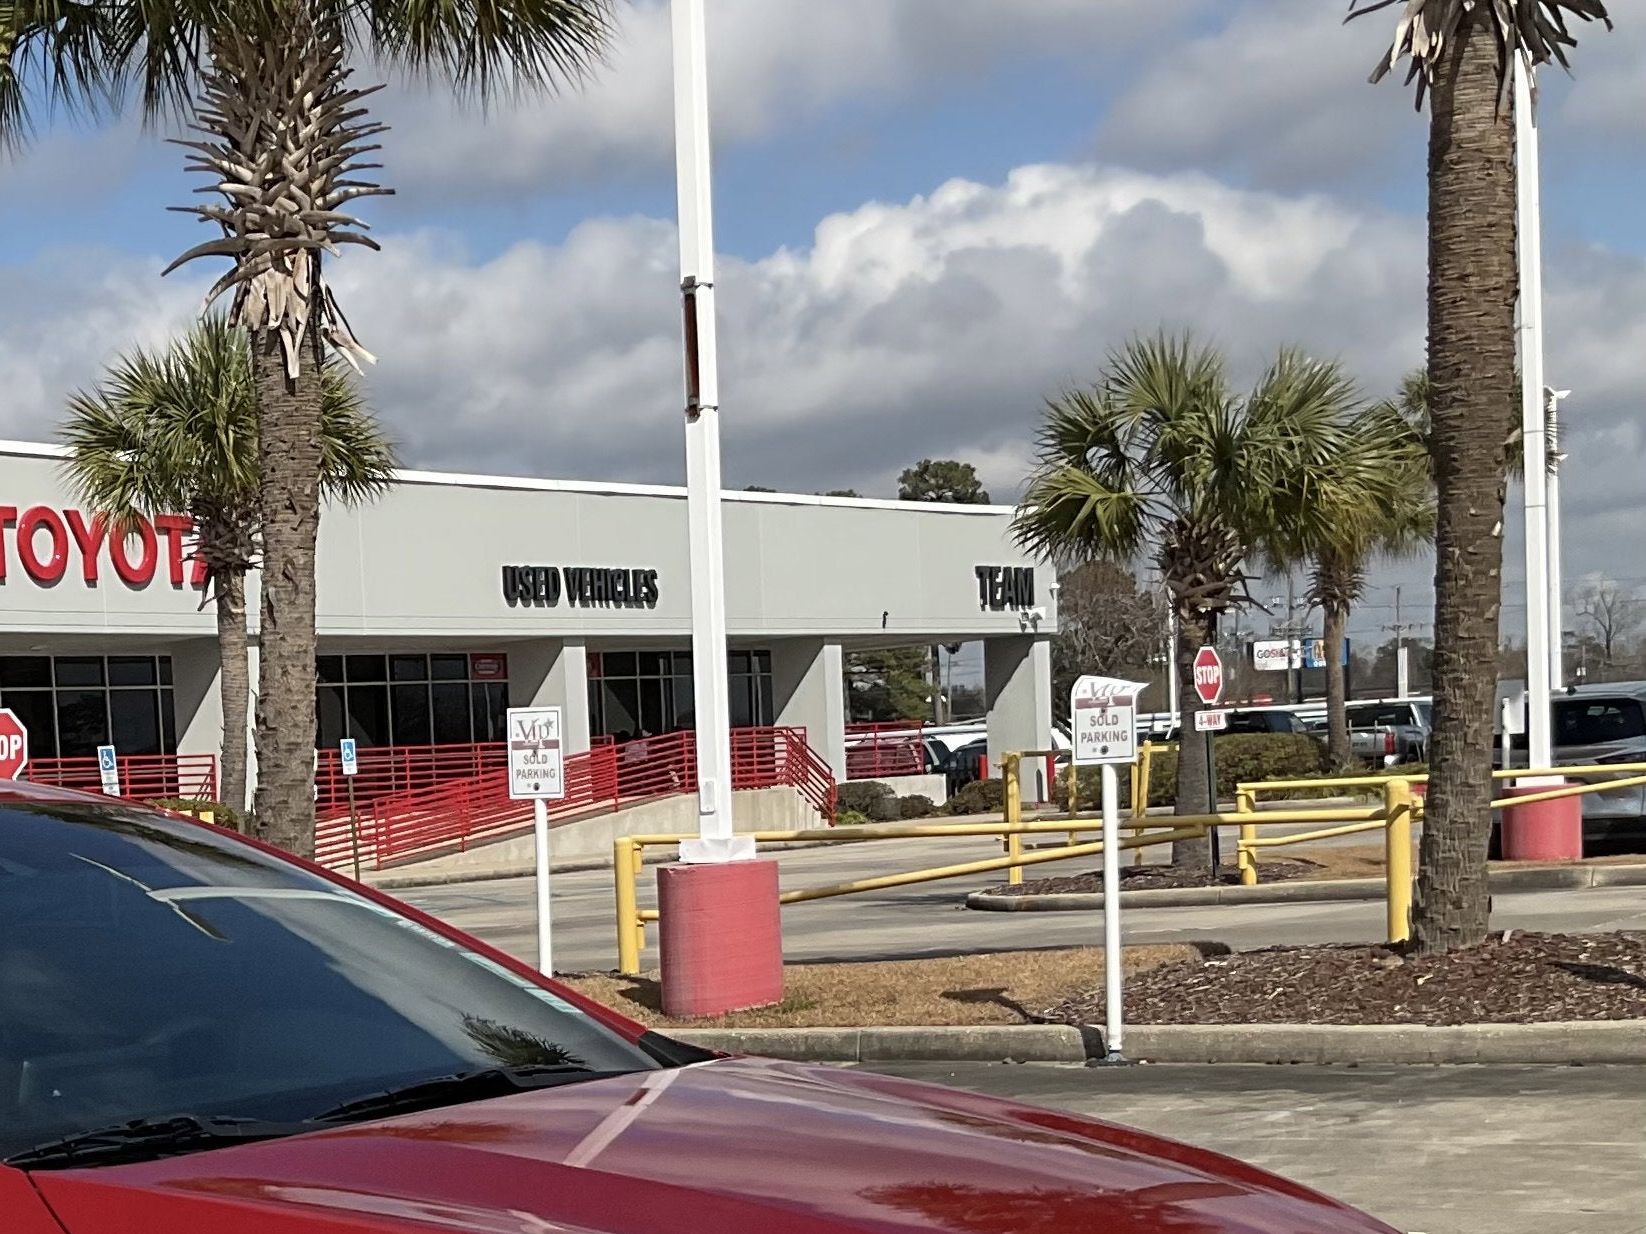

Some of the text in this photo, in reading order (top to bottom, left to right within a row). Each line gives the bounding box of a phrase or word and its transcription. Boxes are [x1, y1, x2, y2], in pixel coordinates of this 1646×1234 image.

[502, 566, 658, 605] USED VEHICLES
[975, 566, 1034, 609] TEAM
[1196, 665, 1220, 685] STOP
[1090, 714, 1119, 727] SOLD
[1198, 713, 1222, 726] 4-WAY
[1080, 730, 1128, 744] PARKING
[523, 754, 548, 765] SOLD
[516, 768, 556, 779] PARKING
